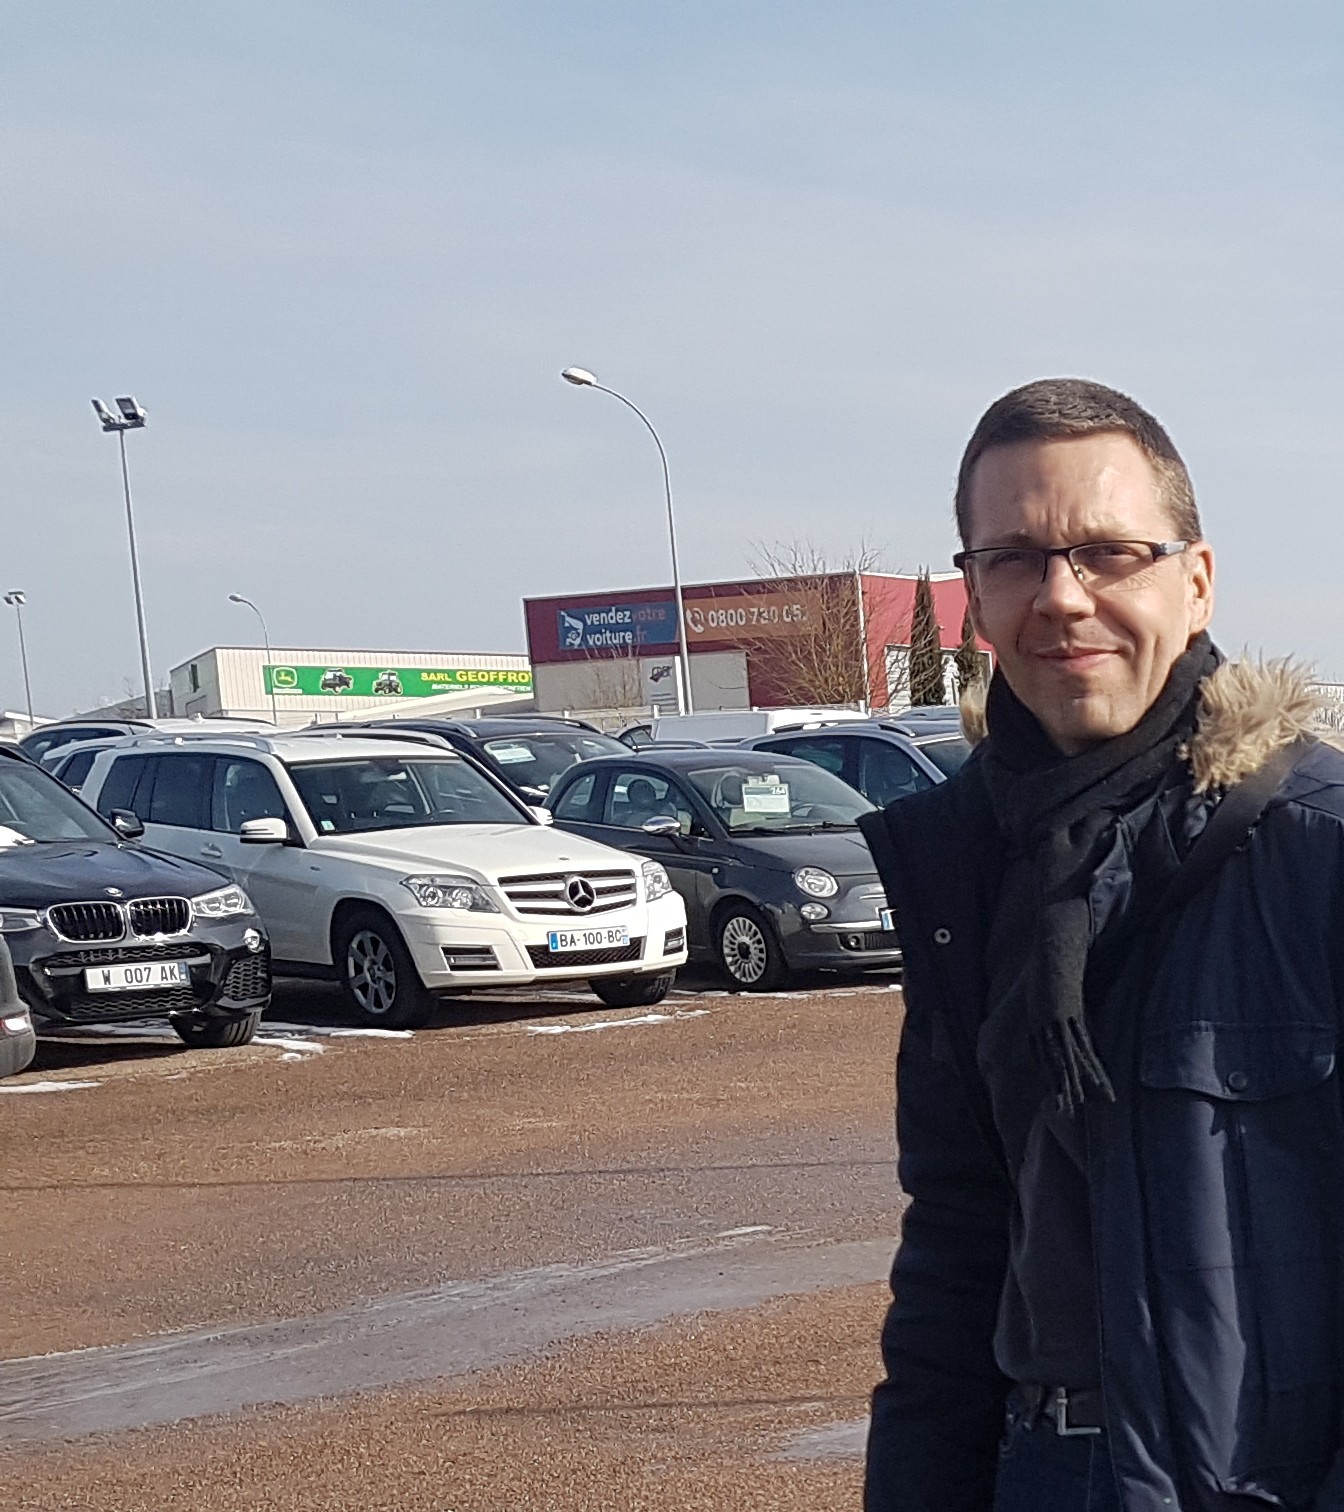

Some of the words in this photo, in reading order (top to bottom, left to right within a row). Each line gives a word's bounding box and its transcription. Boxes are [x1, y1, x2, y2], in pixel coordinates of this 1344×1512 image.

[708, 608, 746, 628] 0800
[420, 672, 452, 681] SARL
[124, 966, 152, 984] 007
[160, 965, 179, 981] AK
